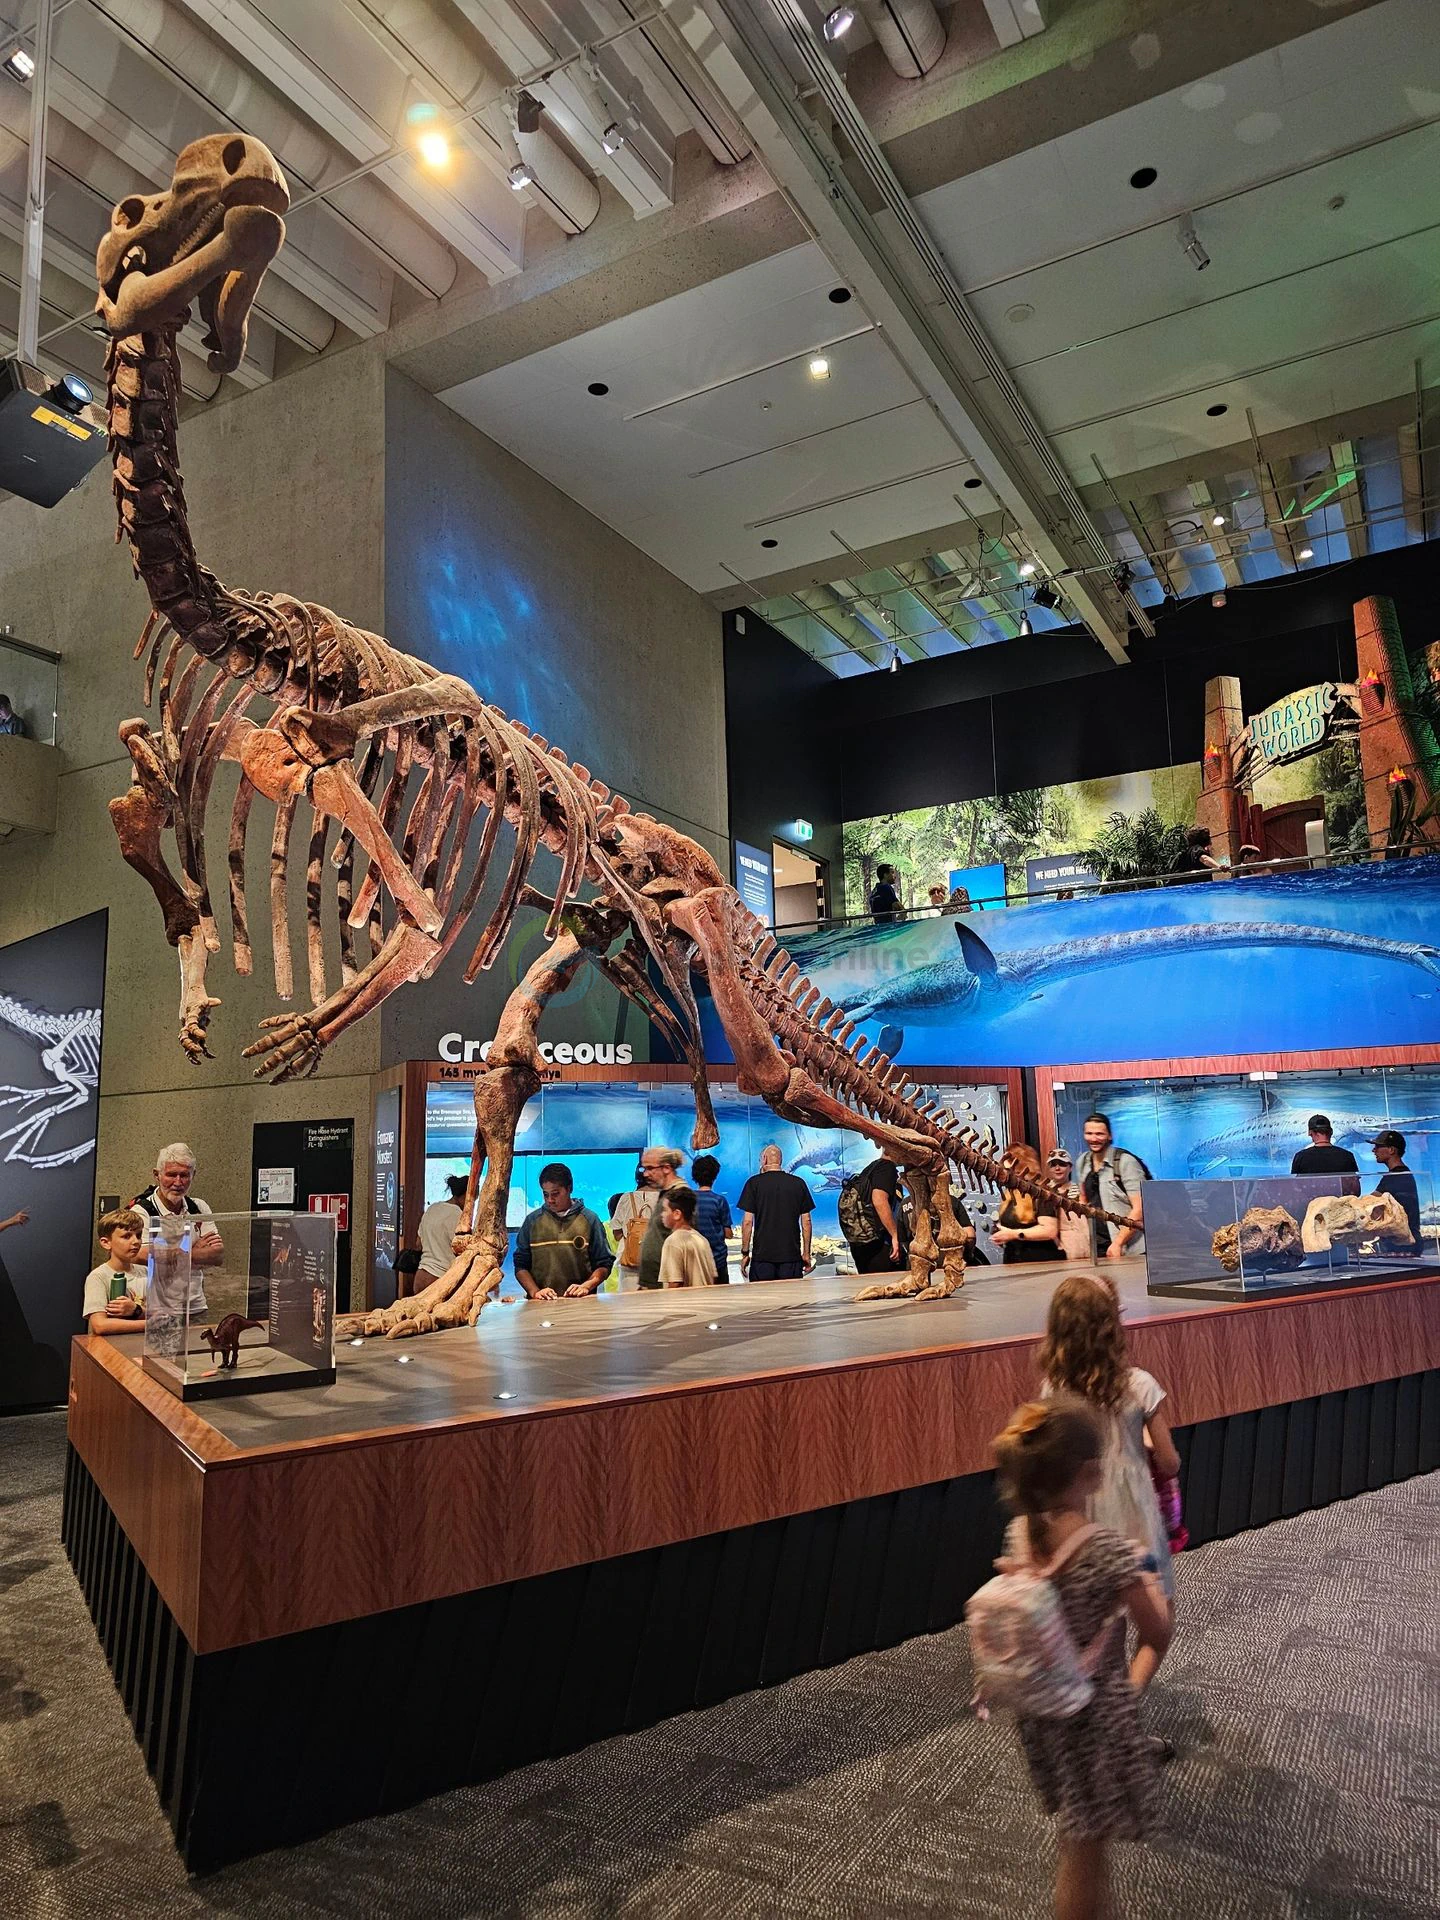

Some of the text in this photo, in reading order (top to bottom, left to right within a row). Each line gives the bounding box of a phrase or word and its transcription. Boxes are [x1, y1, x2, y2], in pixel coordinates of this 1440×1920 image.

[1250, 686, 1333, 743] JURASSIC
[1261, 717, 1321, 759] WORLD
[437, 1032, 633, 1065] Creceous
[440, 1067, 459, 1079] 145
[330, 1127, 349, 1136] Hydrant
